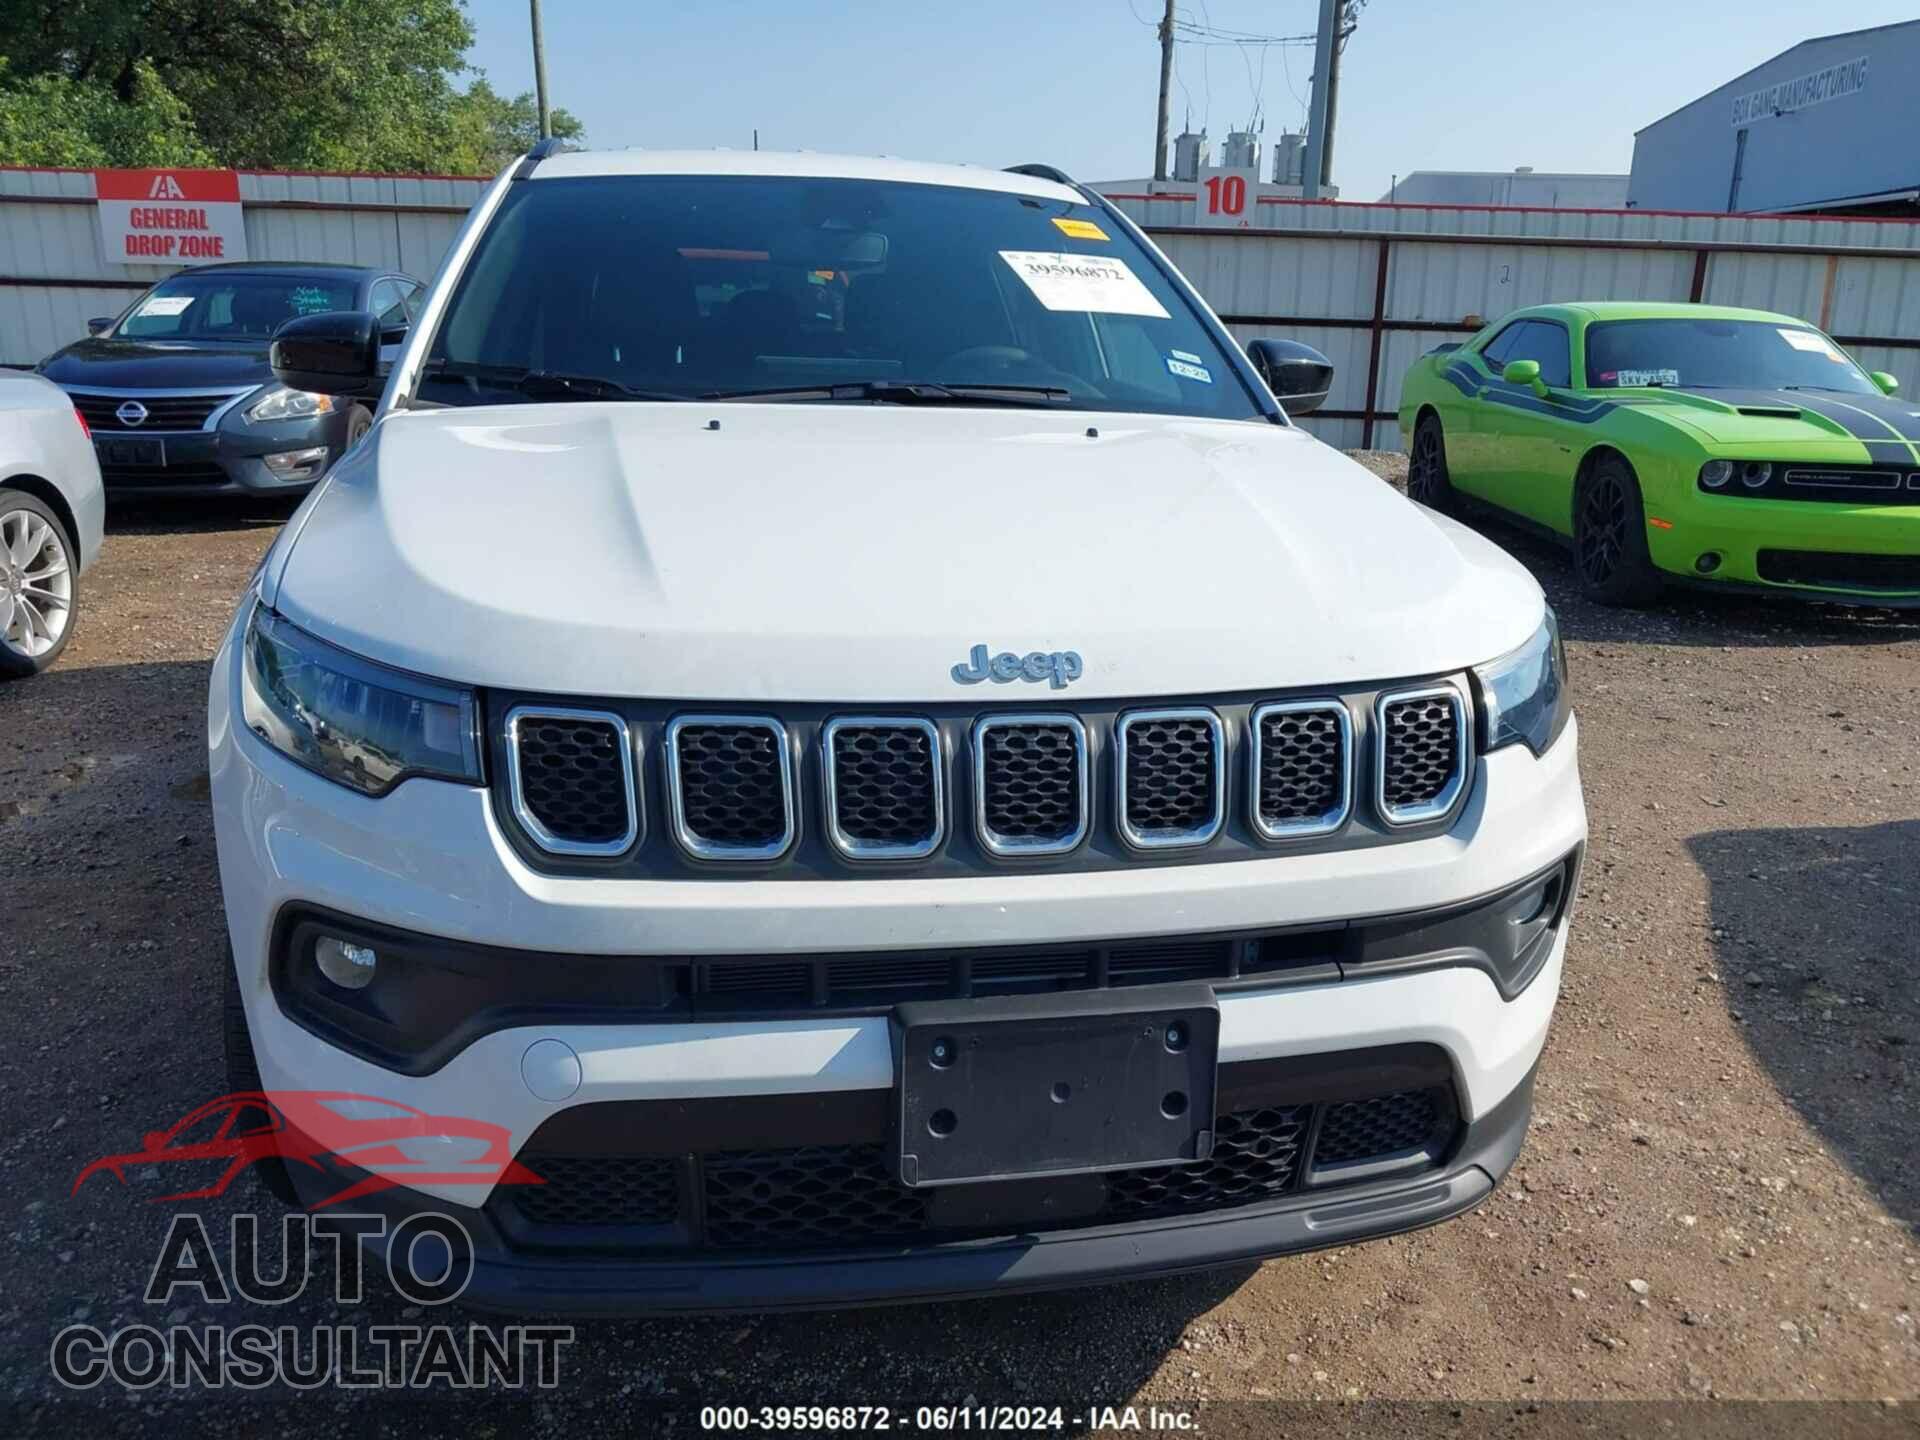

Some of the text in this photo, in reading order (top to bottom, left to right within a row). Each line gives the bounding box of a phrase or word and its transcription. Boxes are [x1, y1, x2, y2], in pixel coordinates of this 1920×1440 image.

[1779, 58, 1868, 107] MANUFACTURING
[1203, 176, 1246, 215] 10
[130, 207, 209, 230] GENERAL
[125, 234, 224, 258] DROP ZONE
[1024, 264, 1125, 281] 39596872
[950, 644, 1083, 690] Jeep
